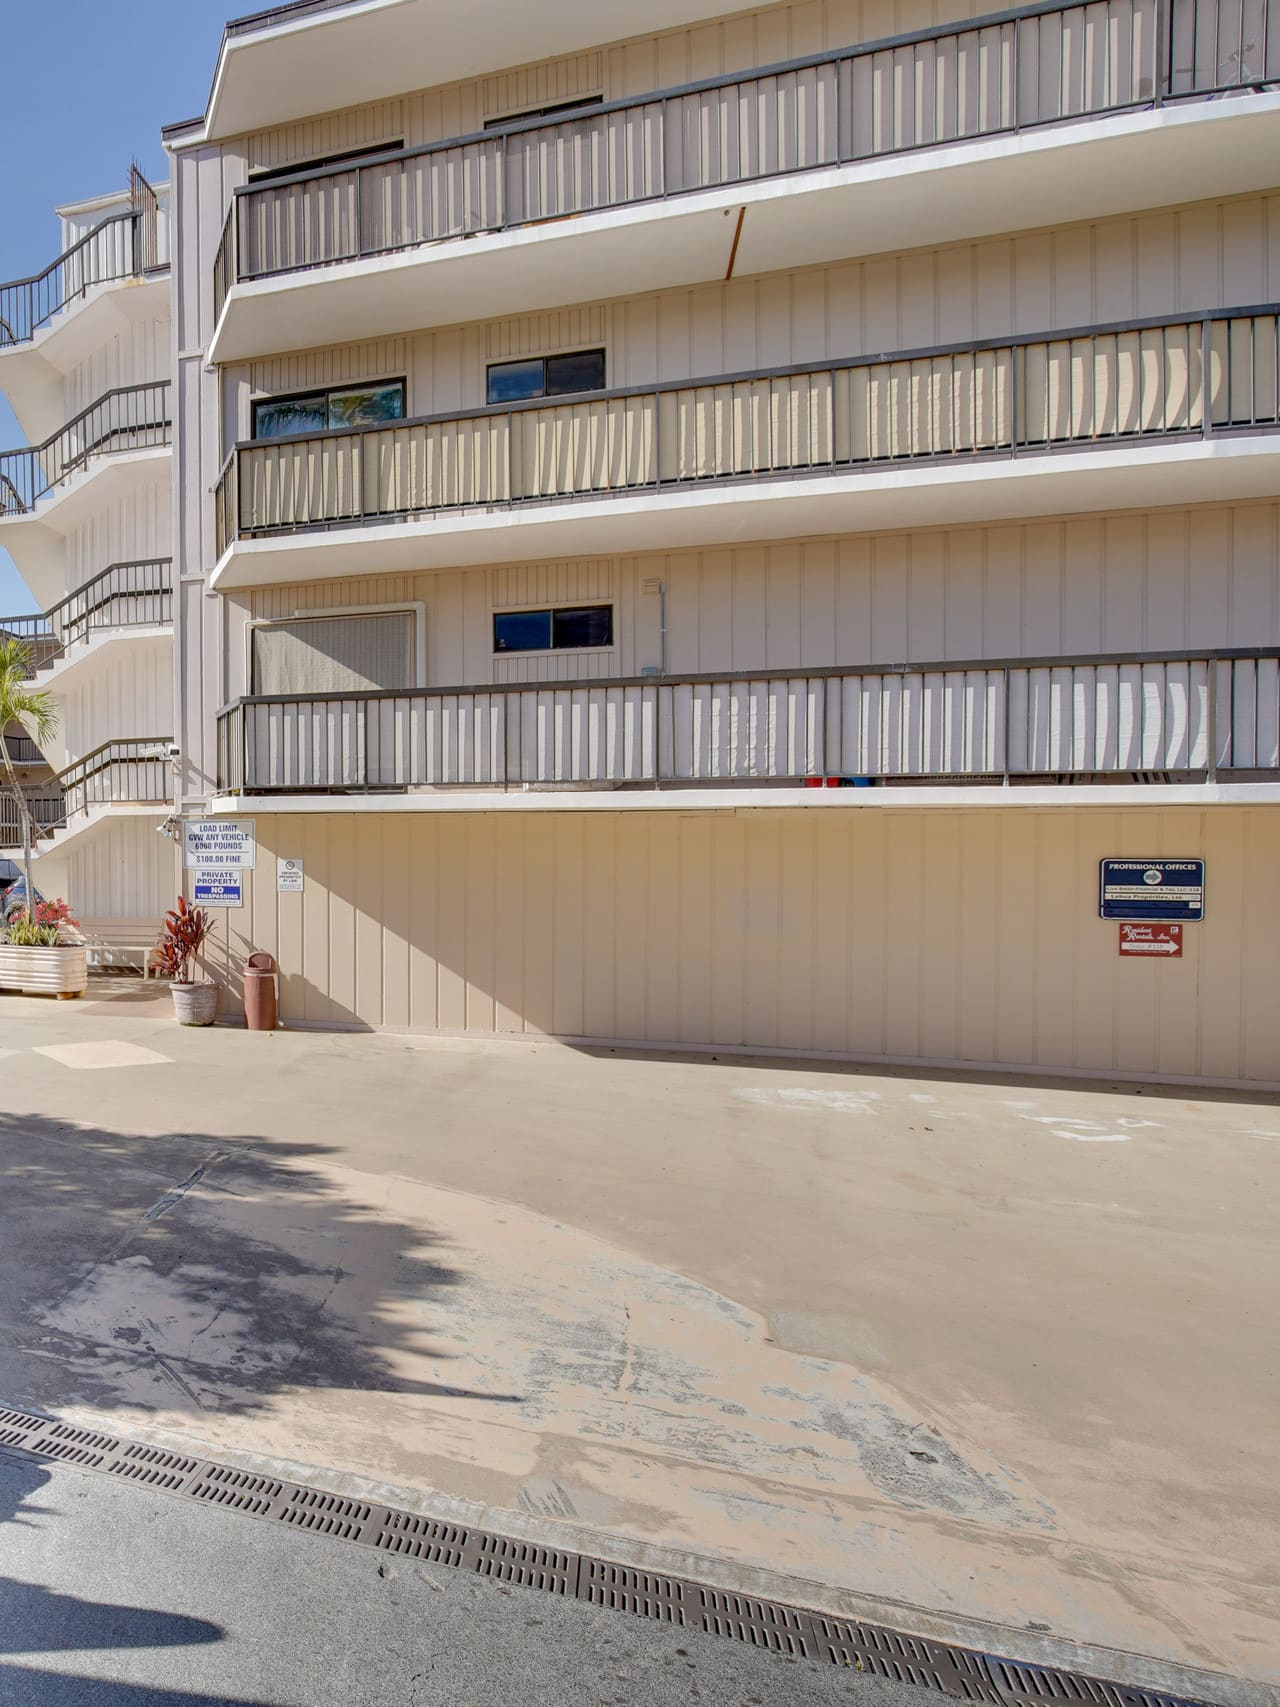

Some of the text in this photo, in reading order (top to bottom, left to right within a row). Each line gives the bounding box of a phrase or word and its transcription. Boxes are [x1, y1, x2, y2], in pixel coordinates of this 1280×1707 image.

[221, 833, 249, 841] VEHICLE
[214, 842, 243, 850] POUNDS
[196, 855, 241, 863] $100.00 FINE
